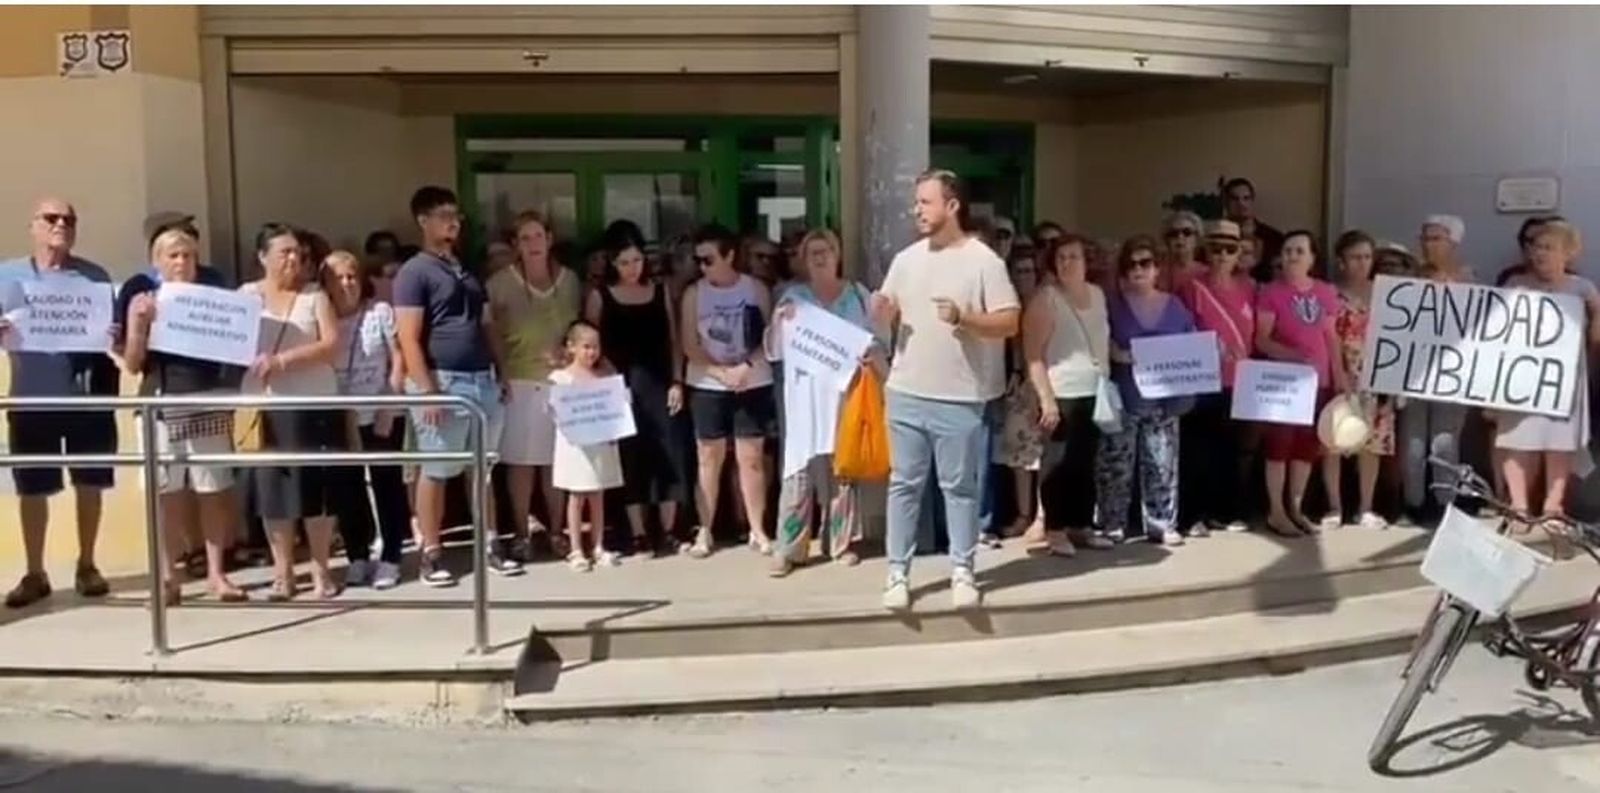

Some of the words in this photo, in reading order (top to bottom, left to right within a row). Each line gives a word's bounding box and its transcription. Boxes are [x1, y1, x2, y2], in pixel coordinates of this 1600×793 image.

[76, 295, 92, 306] EN
[30, 309, 88, 320] ATENCIÓN
[1381, 281, 1565, 348] SANIDAD
[30, 325, 88, 336] PRIMARIA
[802, 328, 849, 358] PERSONAL
[791, 339, 841, 371] SANITARIO
[1153, 358, 1202, 371] PERSONAL
